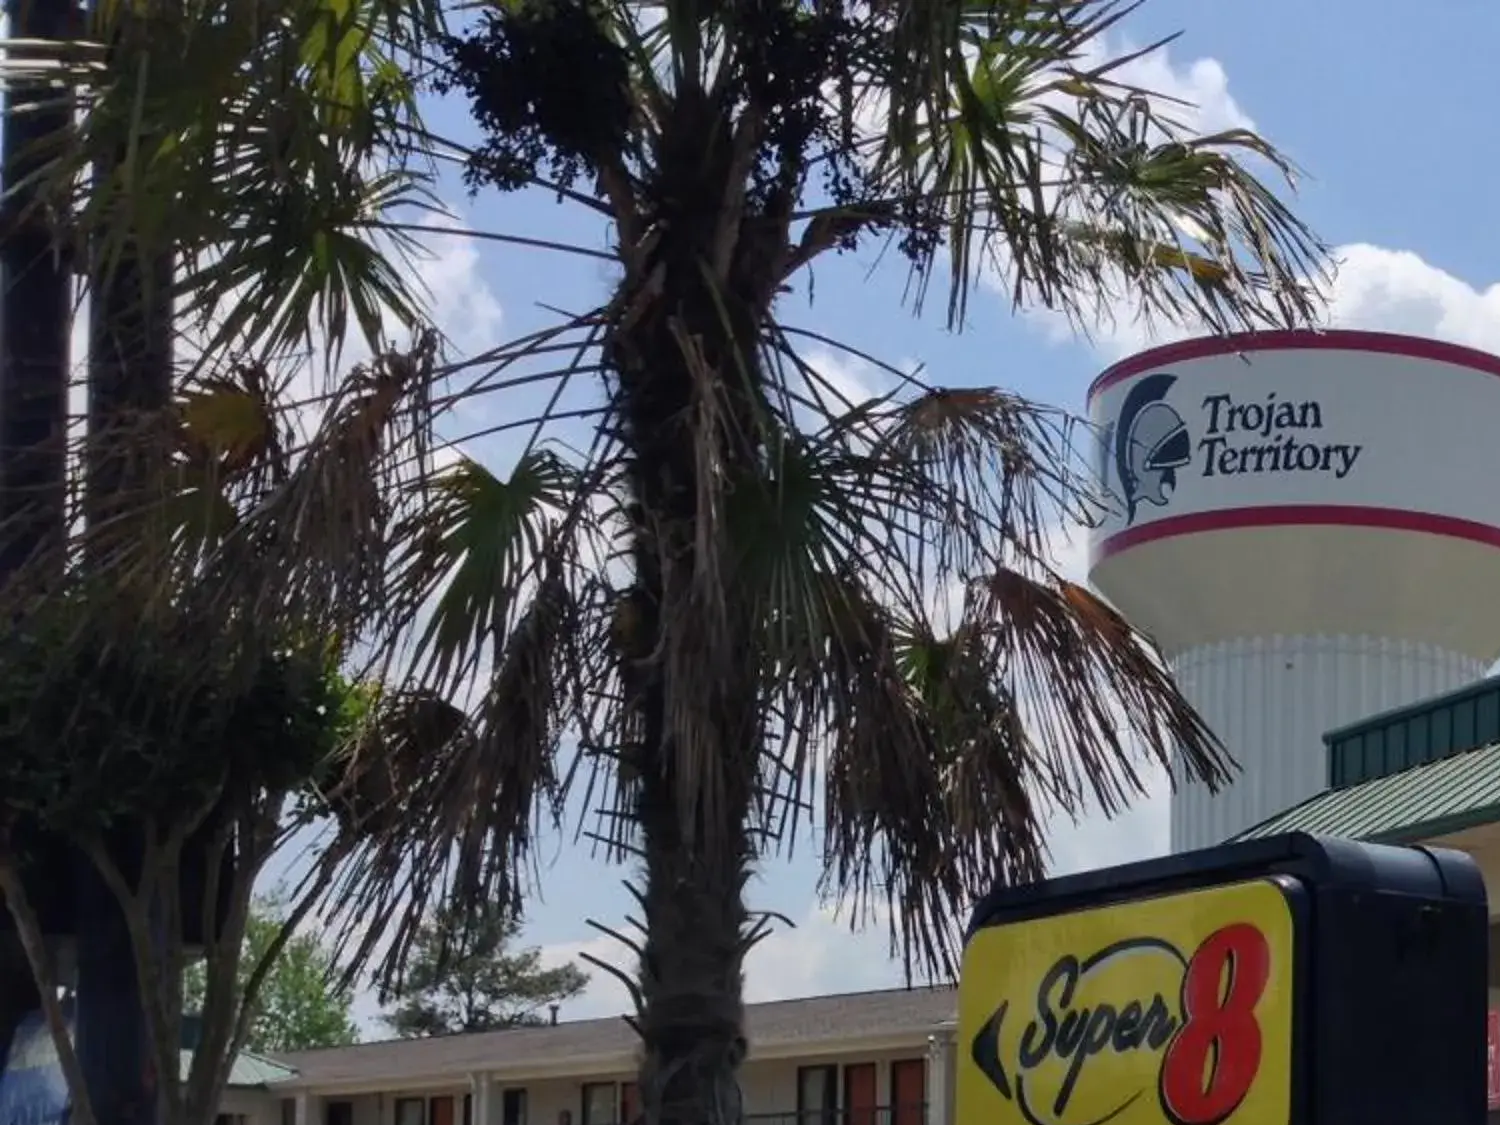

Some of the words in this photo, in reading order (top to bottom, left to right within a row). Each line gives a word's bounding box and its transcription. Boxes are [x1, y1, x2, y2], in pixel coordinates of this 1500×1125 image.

[1201, 392, 1323, 437] Trojan
[1199, 434, 1363, 479] Territory
[1019, 954, 1177, 1118] Super
